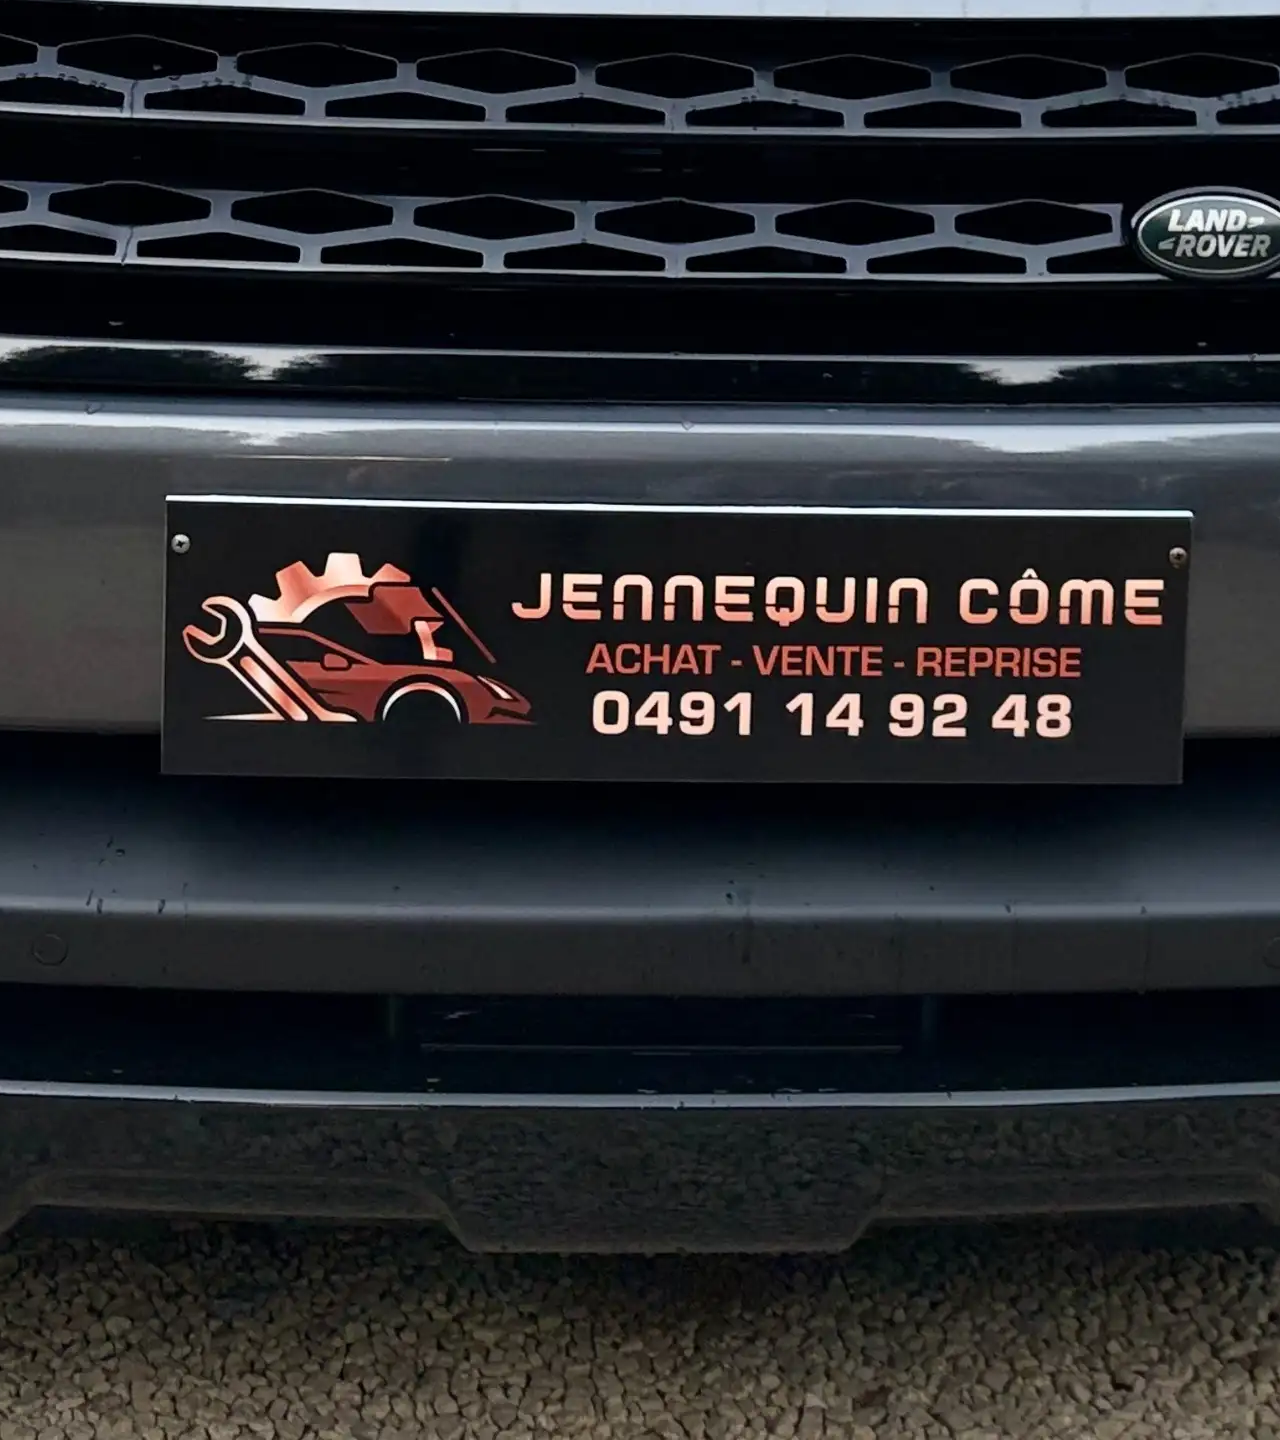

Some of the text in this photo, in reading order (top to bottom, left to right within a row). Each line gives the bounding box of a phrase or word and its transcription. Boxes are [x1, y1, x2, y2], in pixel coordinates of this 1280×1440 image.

[511, 568, 1165, 627] JENNEQUIN CÔME
[585, 643, 722, 675] ACHAT
[752, 645, 884, 677] VENTE
[916, 647, 1083, 679] REPRISE
[592, 690, 1073, 739] 0491 14 92 48
